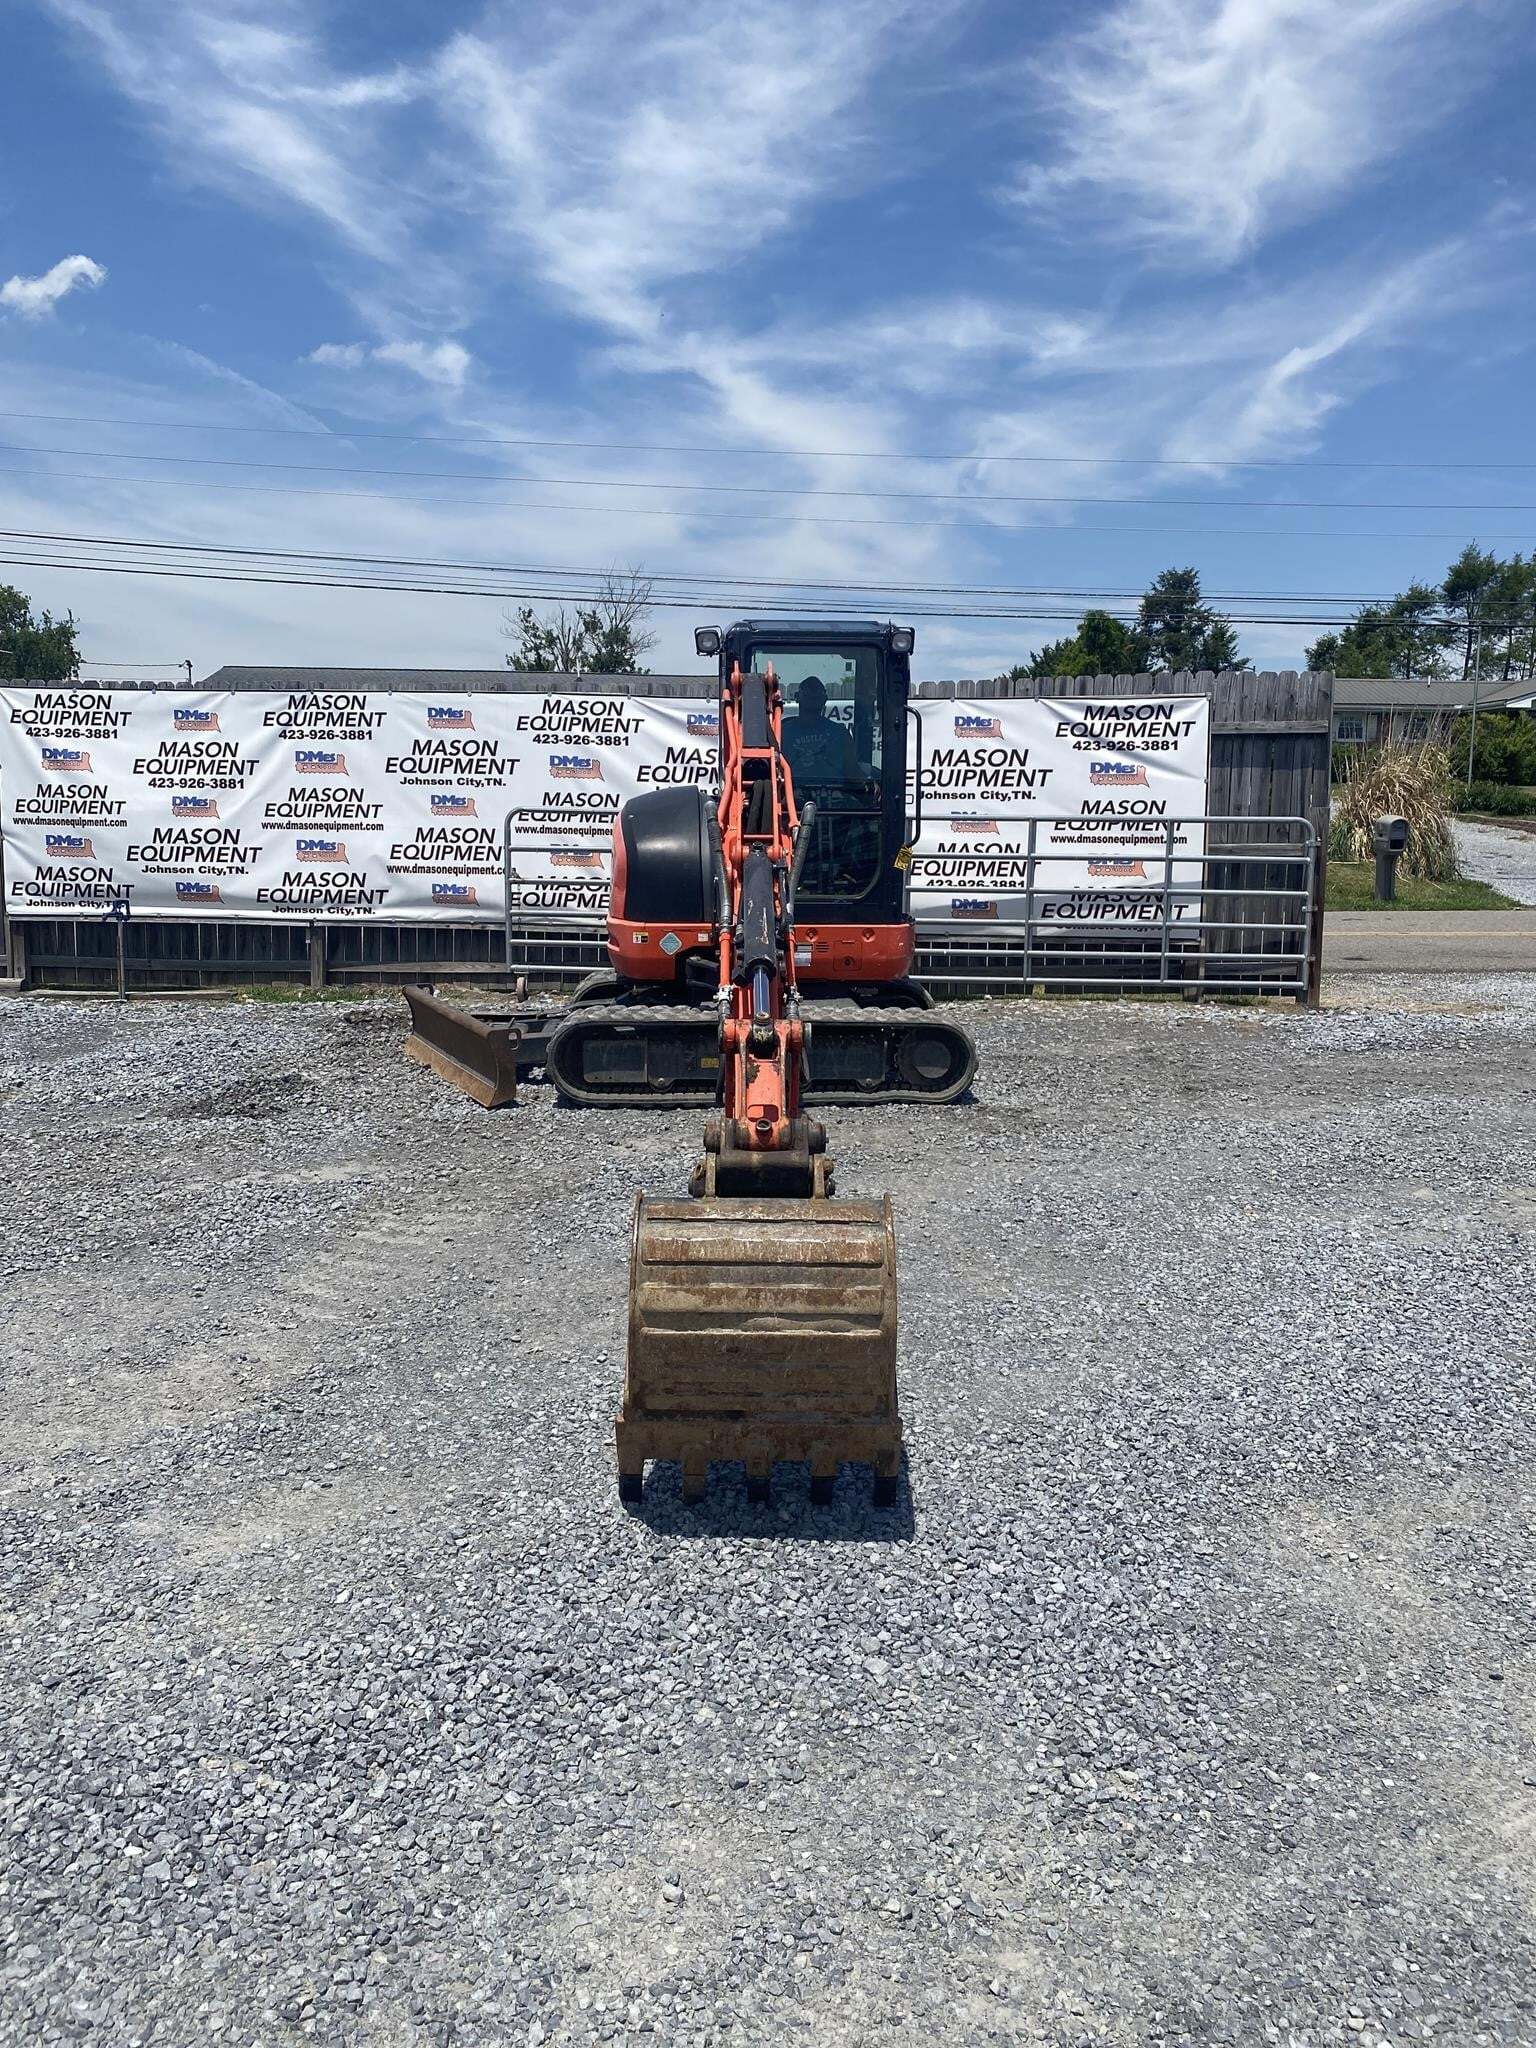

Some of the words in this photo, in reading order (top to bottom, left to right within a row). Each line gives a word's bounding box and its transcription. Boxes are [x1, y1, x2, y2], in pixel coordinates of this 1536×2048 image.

[34, 694, 112, 709] MASON
[288, 695, 367, 710] MASON
[542, 699, 624, 716] MASON
[10, 709, 132, 726] EQUIPMENT
[262, 711, 387, 727] EQUIPMENT
[1084, 704, 1174, 720] MASON
[516, 716, 645, 733] EQUIPMENT
[1056, 721, 1195, 738] EQUIPMENT
[26, 727, 118, 739] 423-926-3881
[279, 729, 373, 740] 423-926-3881
[532, 734, 629, 746] 423-926-3881
[158, 742, 239, 758] MASON
[411, 740, 499, 757] MASON
[1073, 740, 1179, 751] 423-926-3881
[385, 757, 521, 775] EQUIPMENT
[931, 749, 1029, 767] MASON
[133, 759, 259, 776] EQUIPMENT
[148, 778, 244, 789] 423-926-3881
[400, 777, 453, 786] Johnson
[905, 769, 1053, 787] EQUIPMENT
[36, 784, 108, 799] MASON
[288, 787, 364, 803] MASON
[542, 792, 620, 807] MASON
[15, 799, 127, 815] EQUIPMENT
[264, 803, 383, 819] EQUIPMENT
[1080, 800, 1166, 815] MASON
[13, 816, 128, 828] www.dmasonequipment.com
[518, 813, 616, 823] EQUIPME
[261, 821, 384, 832] www.dmasonequipment.com
[152, 828, 240, 845] MASON
[415, 827, 496, 844] MASON
[1050, 834, 1187, 845] www.dmasonequipment.om
[126, 846, 263, 863] EQUIPMENT
[35, 866, 113, 882] MASON
[141, 865, 195, 875] Johnson
[911, 860, 1041, 878] EQUIPMEN
[282, 872, 367, 887] MASON
[11, 882, 135, 898] EQUIPMENT
[256, 888, 389, 905] EQUIPMENT
[26, 899, 75, 908] Johnson
[78, 900, 113, 909] City,T
[272, 906, 324, 915] Johnson
